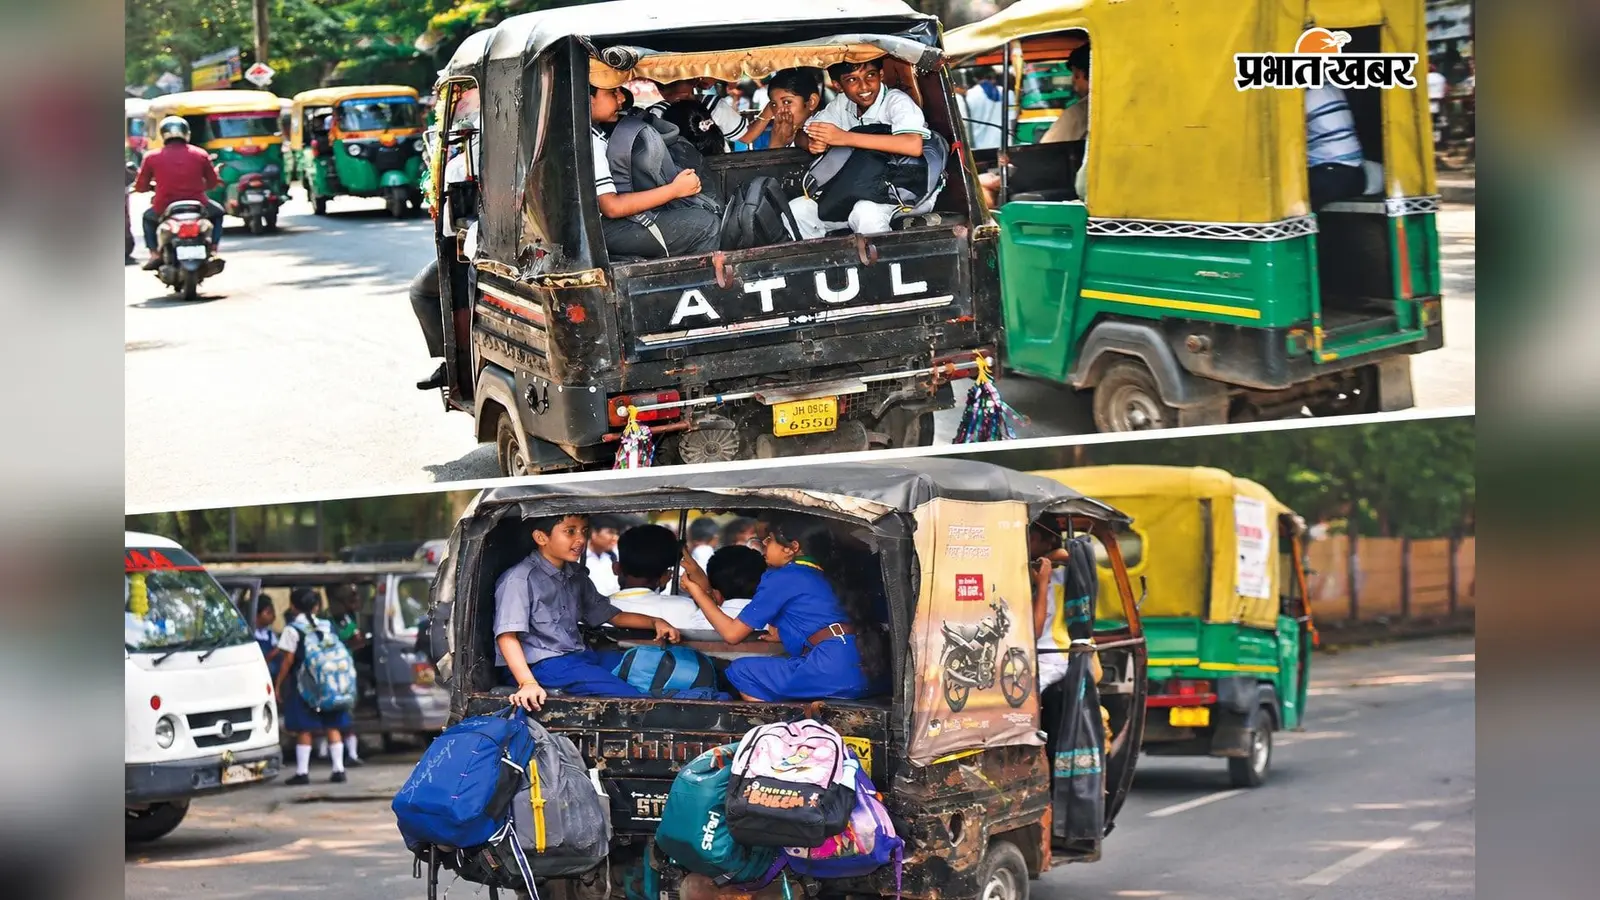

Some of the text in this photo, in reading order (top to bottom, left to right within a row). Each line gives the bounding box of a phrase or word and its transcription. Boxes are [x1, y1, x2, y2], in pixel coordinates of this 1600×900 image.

[670, 262, 928, 325] ATUL
[792, 406, 805, 416] JH
[789, 417, 834, 431] 6550
